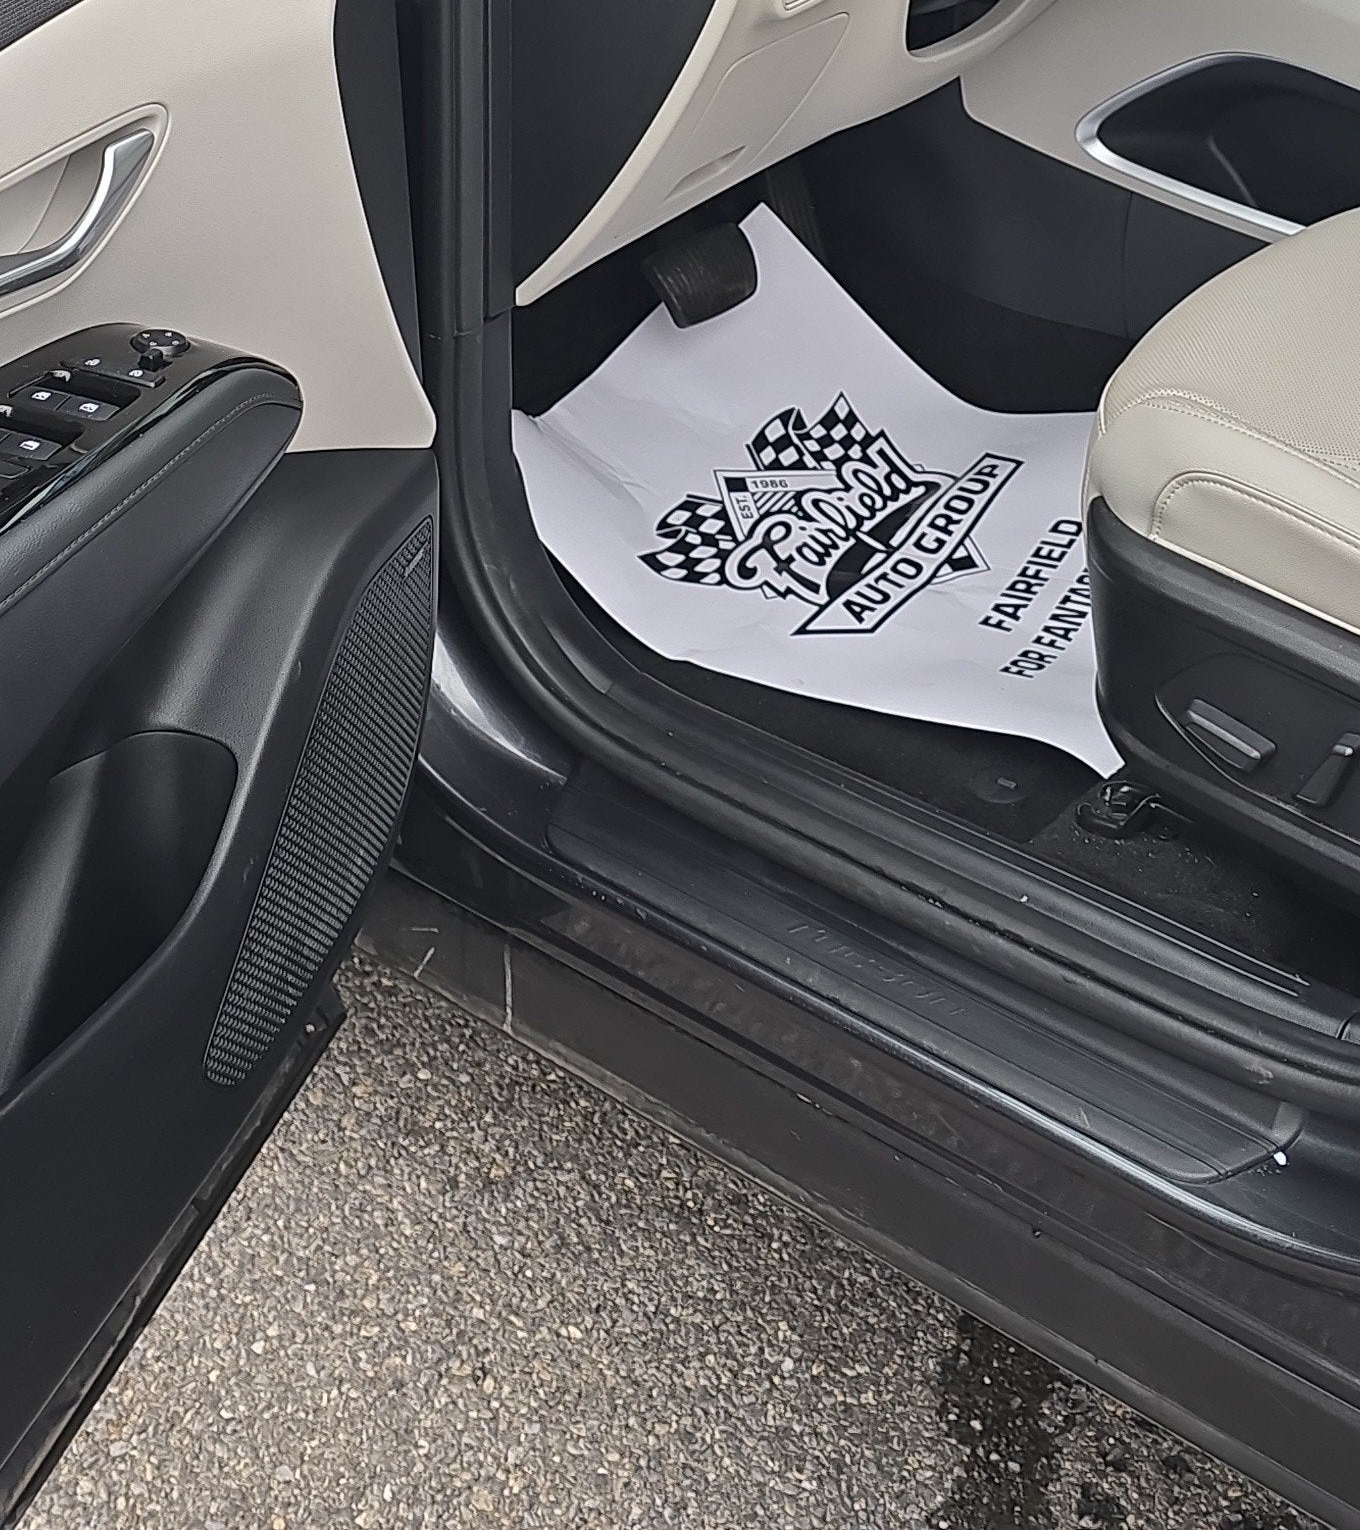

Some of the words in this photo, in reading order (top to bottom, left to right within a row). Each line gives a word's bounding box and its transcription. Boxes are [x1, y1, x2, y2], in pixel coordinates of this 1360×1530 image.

[736, 446, 930, 595] Fairfield
[751, 479, 789, 489] 1986
[840, 556, 924, 626] AUTO
[912, 462, 1001, 556] GROUP
[977, 519, 1083, 633] FAIRFIELD
[998, 649, 1058, 679] FOR
